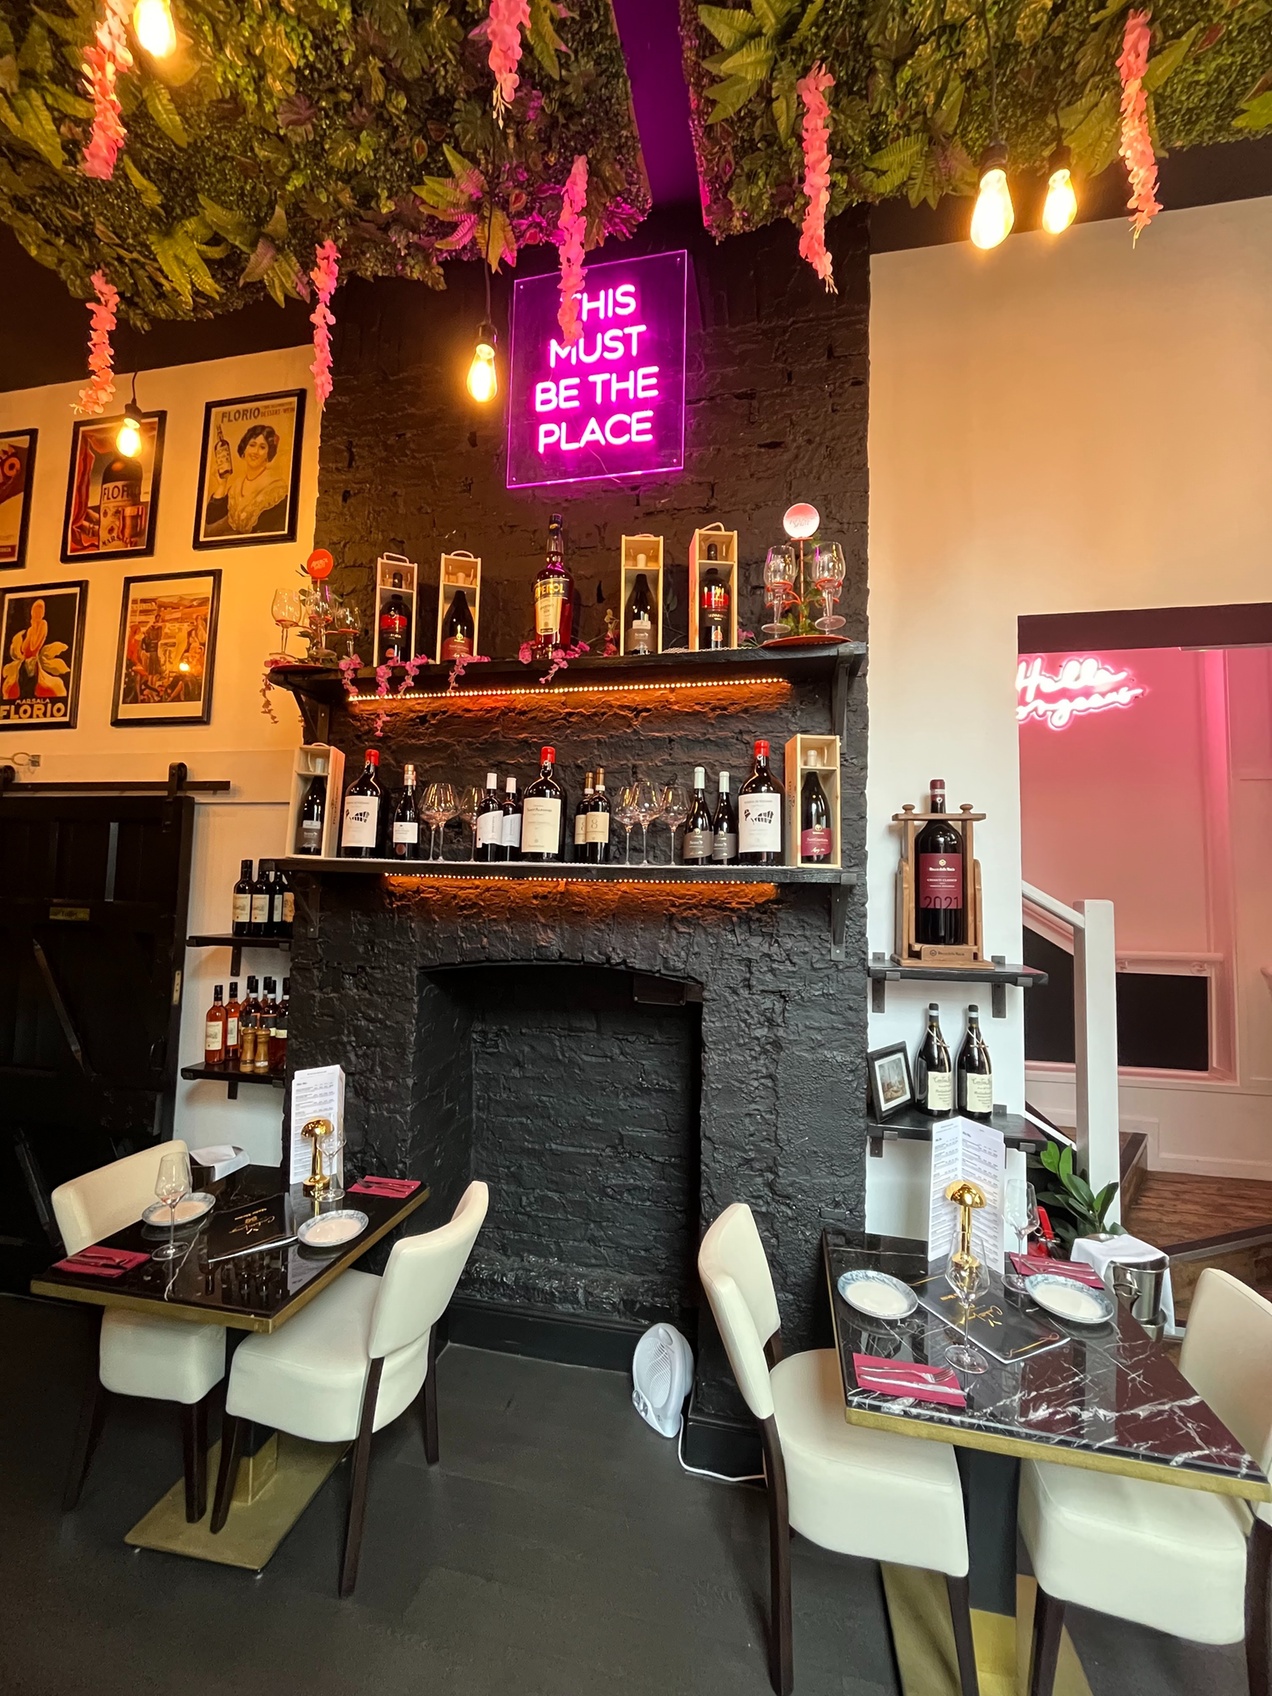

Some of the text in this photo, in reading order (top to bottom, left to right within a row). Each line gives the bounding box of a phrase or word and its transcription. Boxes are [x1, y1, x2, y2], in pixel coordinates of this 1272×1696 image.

[561, 284, 636, 322] HIS
[549, 324, 647, 368] MUST
[535, 365, 660, 412] BE THE
[221, 407, 260, 423] FLORIO
[538, 410, 654, 454] PLACE
[0, 702, 65, 719] FLORIO
[924, 895, 959, 909] 2021
